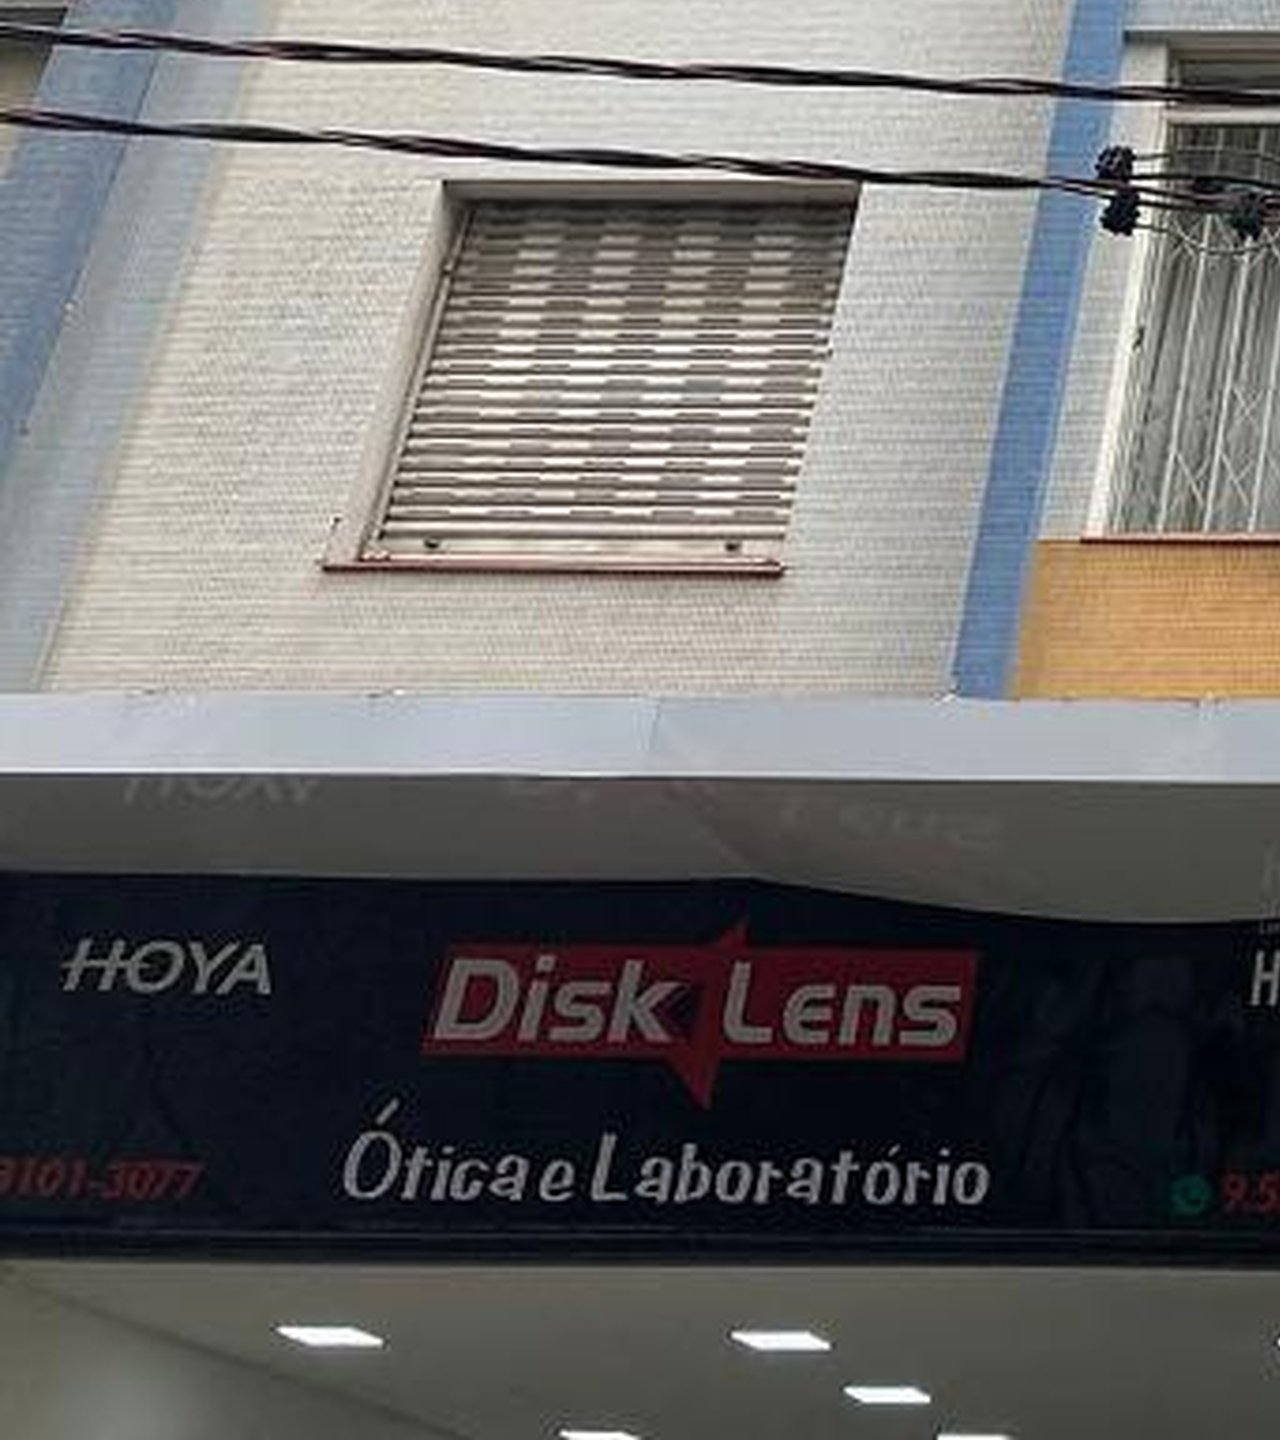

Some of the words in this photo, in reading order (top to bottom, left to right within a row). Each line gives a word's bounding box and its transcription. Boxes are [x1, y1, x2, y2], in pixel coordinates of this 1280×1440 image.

[60, 938, 274, 996] HOYA
[432, 953, 688, 1044] Disk
[720, 956, 963, 1048] Lens
[341, 1099, 527, 1201] Ótica
[536, 1158, 576, 1201] e
[590, 1133, 990, 1205] Laboratório
